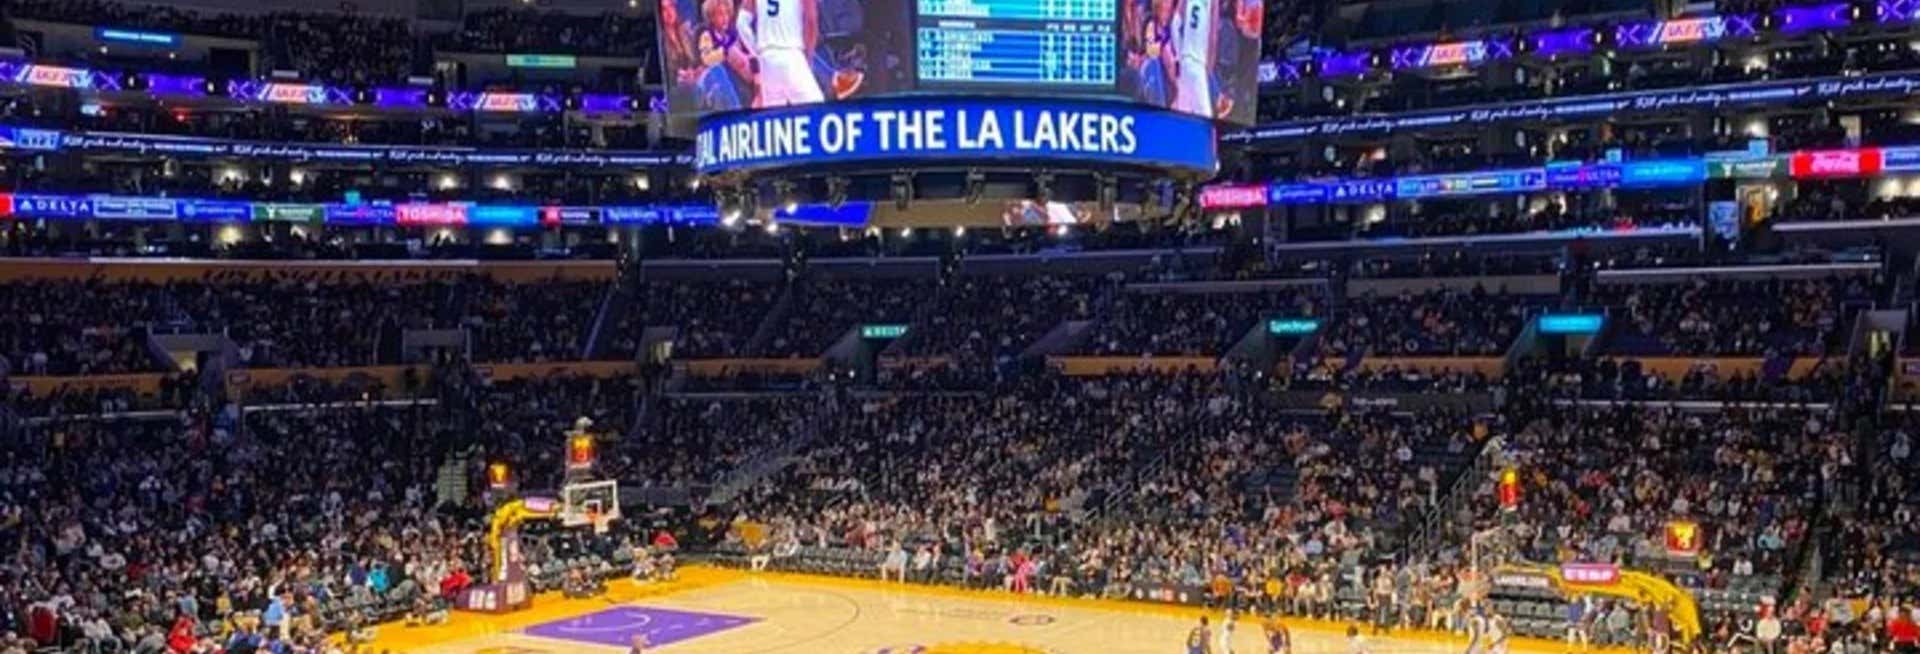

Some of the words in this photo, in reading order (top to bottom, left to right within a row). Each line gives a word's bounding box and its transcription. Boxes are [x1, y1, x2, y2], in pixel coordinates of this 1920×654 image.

[719, 115, 811, 164] AIRLINE
[819, 113, 863, 153] OF
[872, 110, 947, 151] THE
[957, 109, 1004, 149] LA
[1014, 109, 1137, 154] LAKERS
[1349, 183, 1393, 196] DELTA
[36, 200, 90, 213] DELTA
